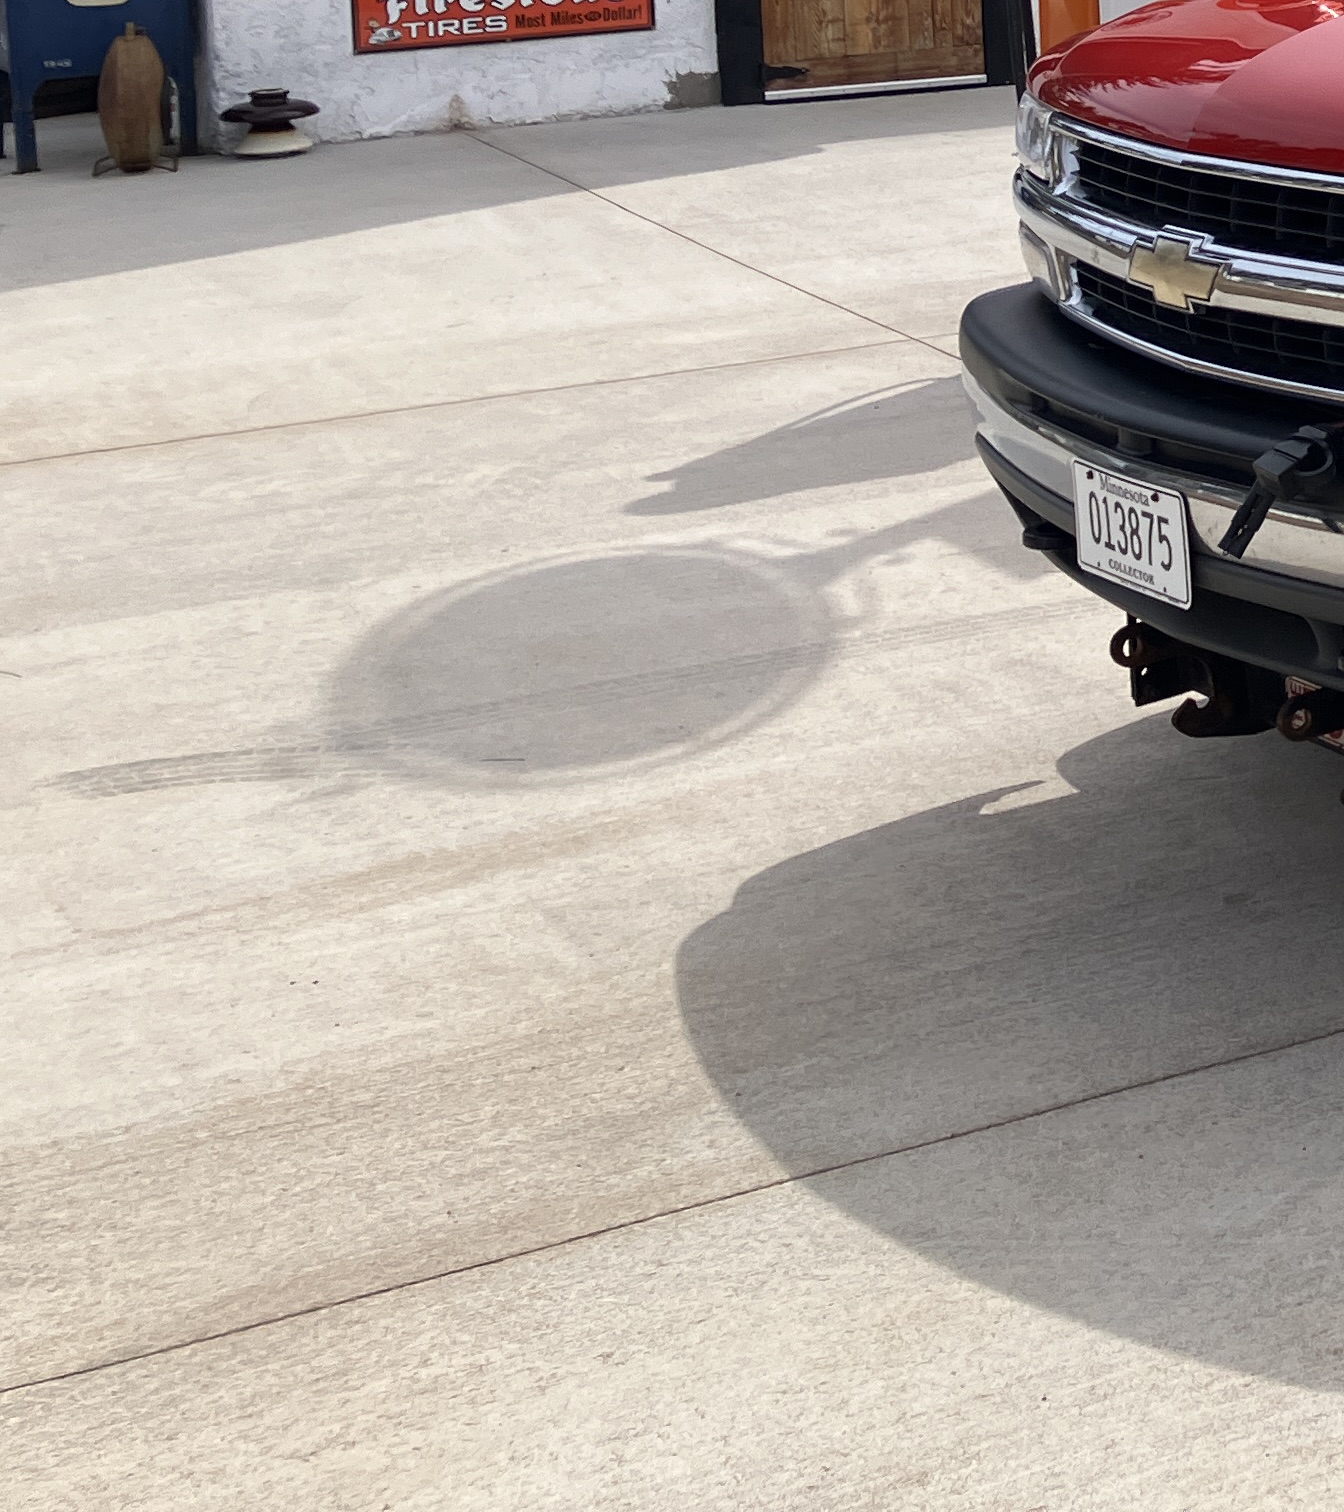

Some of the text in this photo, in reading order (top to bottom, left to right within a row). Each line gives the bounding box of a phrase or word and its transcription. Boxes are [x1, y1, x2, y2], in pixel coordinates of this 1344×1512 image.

[402, 15, 508, 39] TIRES
[515, 13, 546, 29] Most
[551, 10, 584, 25] Miles
[603, 5, 642, 22] Dollar!
[1099, 473, 1150, 507] Minnesota
[1089, 490, 1172, 571] 013875
[1108, 558, 1155, 585] COLLECTOR
